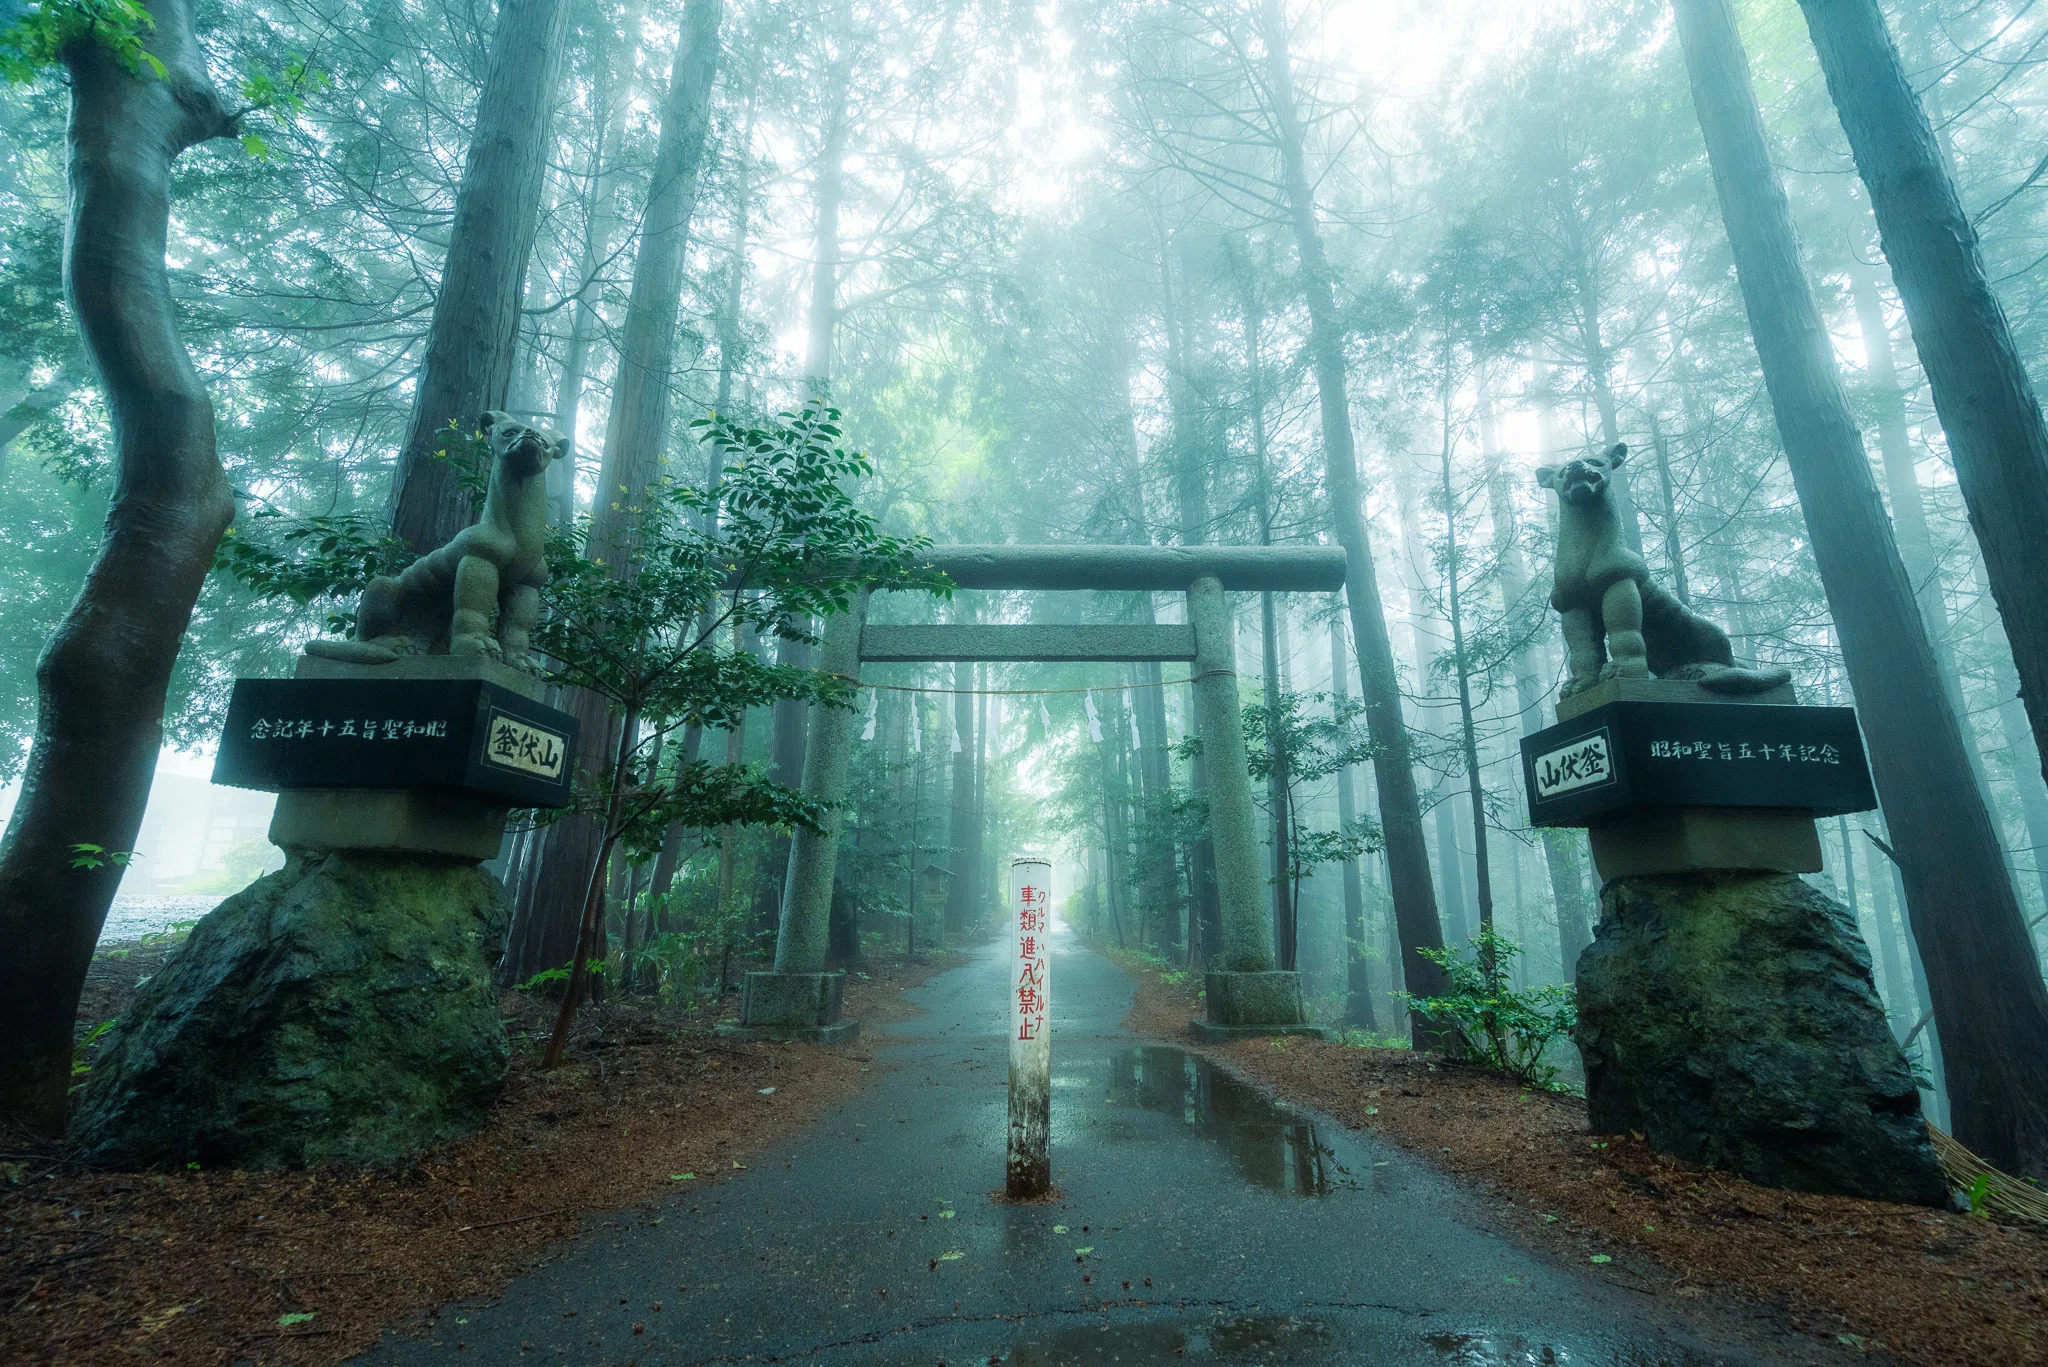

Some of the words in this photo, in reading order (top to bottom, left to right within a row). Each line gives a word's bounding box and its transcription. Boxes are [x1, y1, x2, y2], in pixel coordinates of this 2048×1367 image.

[493, 723, 559, 770] 釜伏山
[1650, 740, 1840, 765] 昭和聖旨五十年記念
[1018, 885, 1037, 1041] 車類進入禁止
